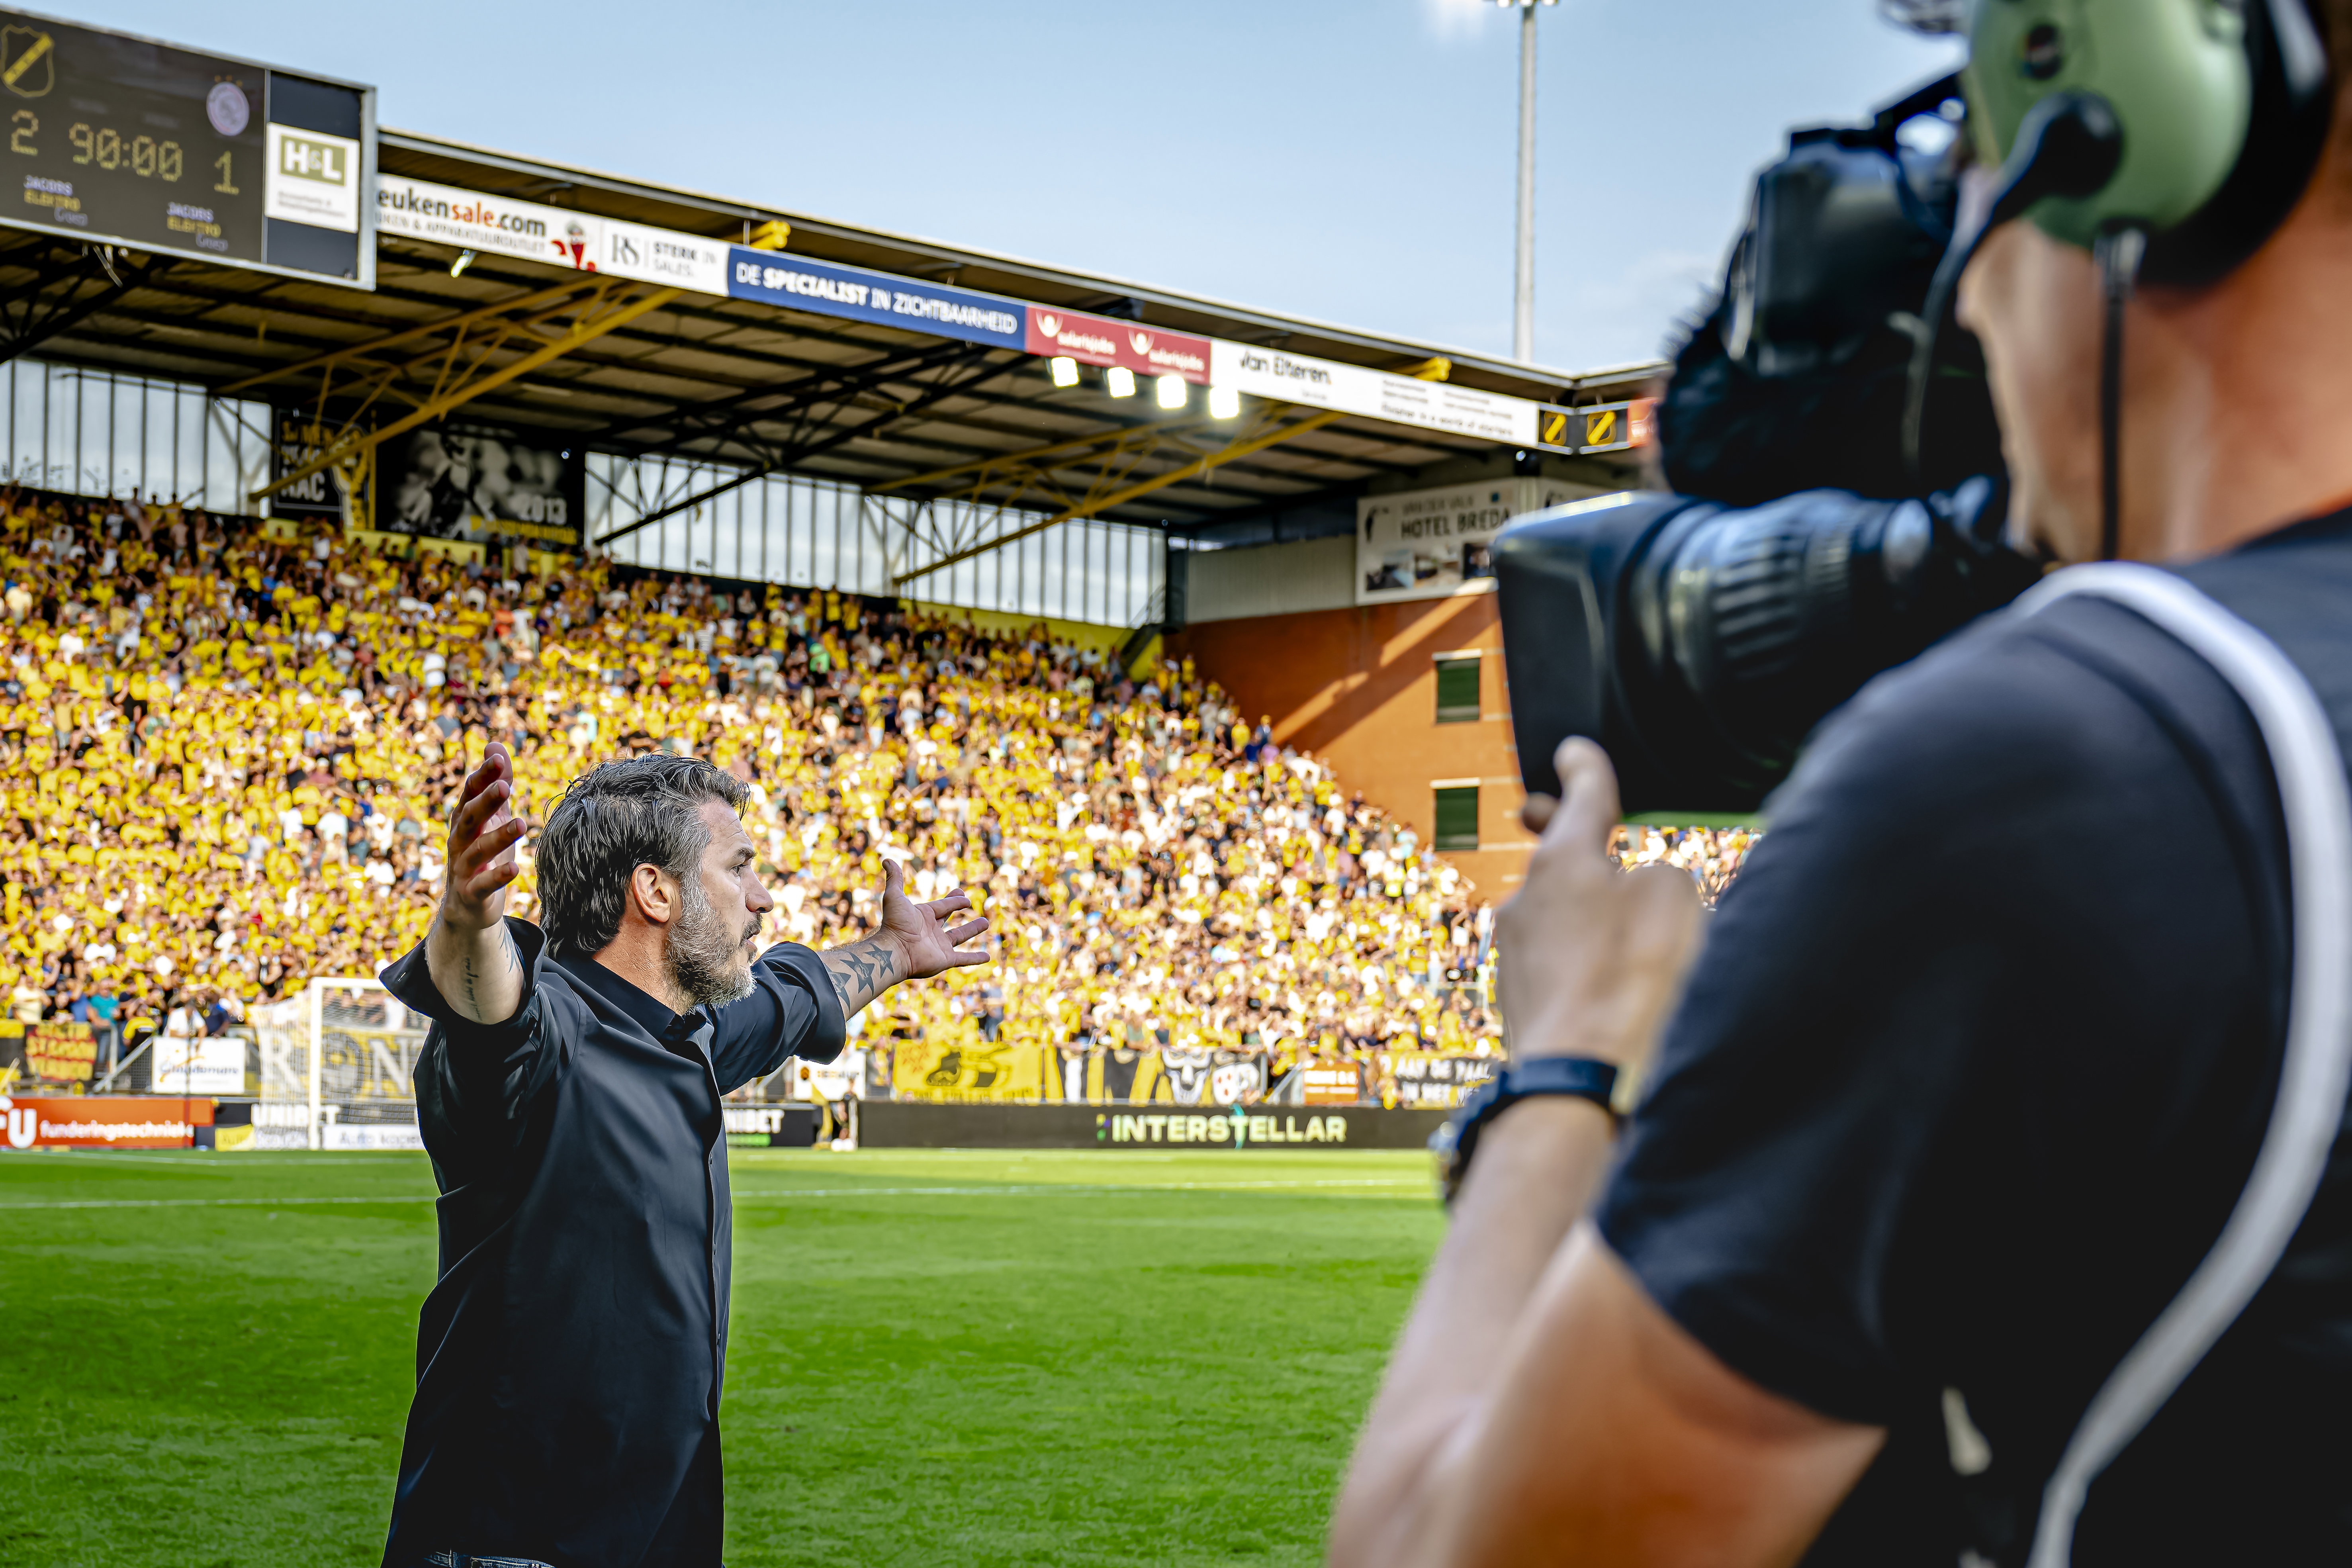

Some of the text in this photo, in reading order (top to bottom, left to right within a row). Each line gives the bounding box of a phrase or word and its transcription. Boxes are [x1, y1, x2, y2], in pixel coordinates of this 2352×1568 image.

[11, 110, 239, 195] 2 90:00 1
[377, 187, 546, 237] eukensale.com
[736, 261, 1018, 334] DE SPECIALIST IN ZICHTBAARHEID
[1401, 507, 1510, 539] HOTEL BREDA
[251, 1103, 339, 1127] UNIBT
[724, 1108, 785, 1133] NIBET
[1112, 1115, 1347, 1143] INTERSTELLAR
